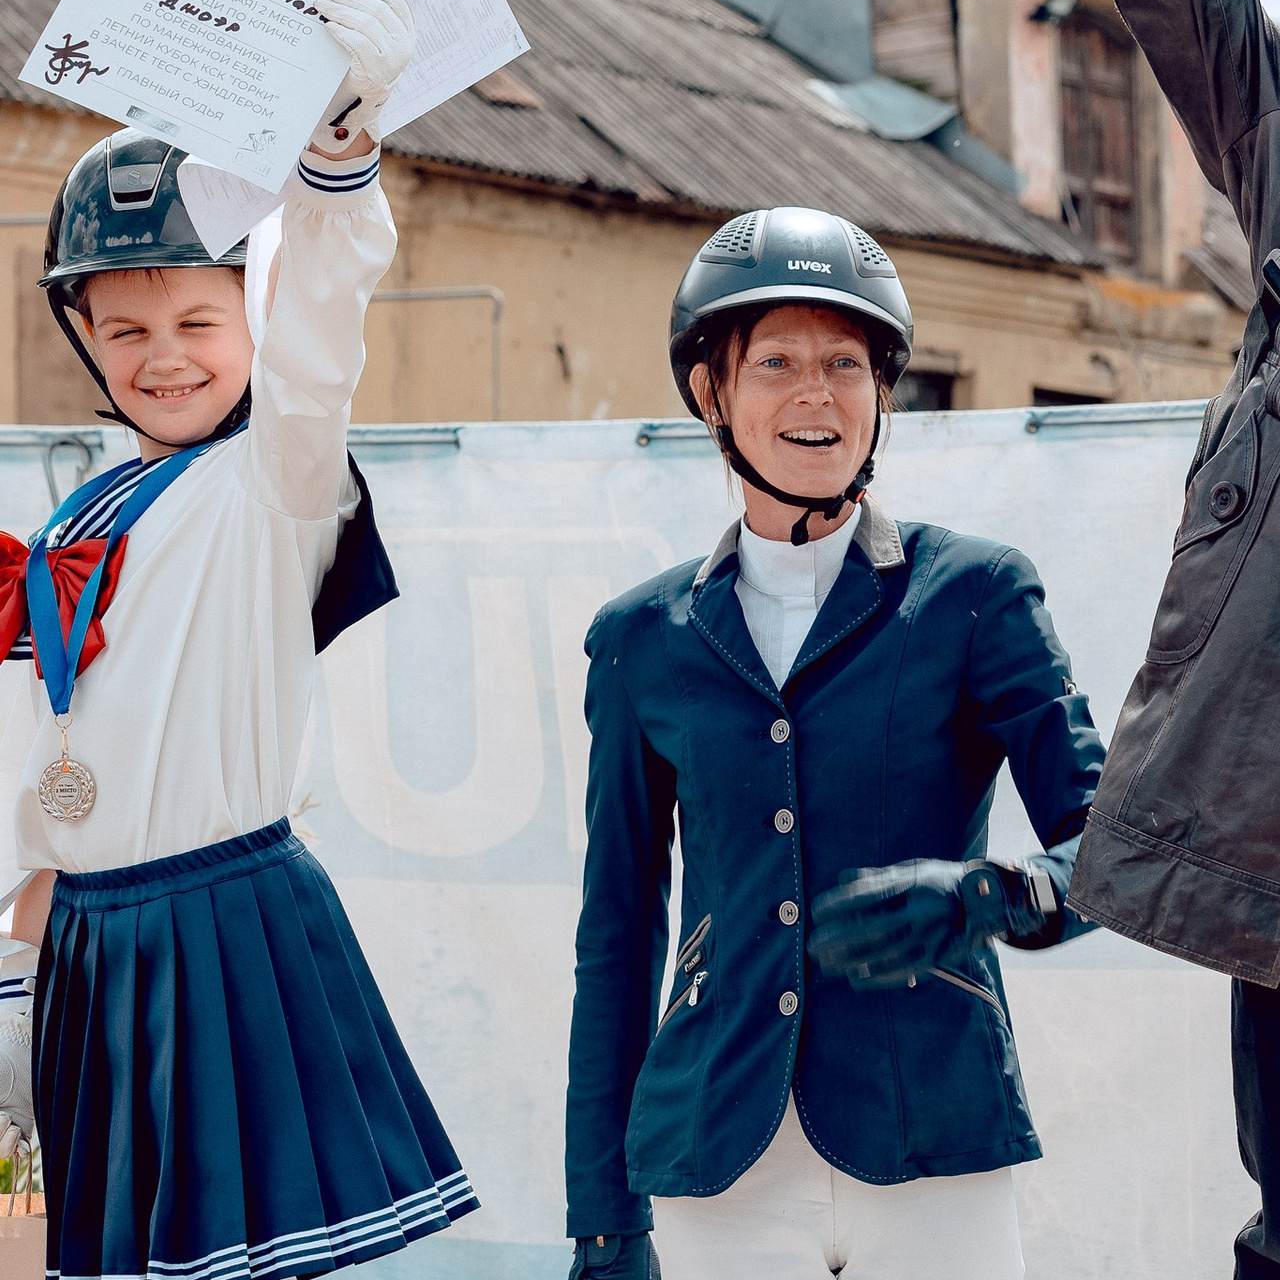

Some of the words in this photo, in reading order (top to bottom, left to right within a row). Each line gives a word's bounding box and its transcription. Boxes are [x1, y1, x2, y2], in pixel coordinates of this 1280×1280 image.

[131, 13, 152, 30] ПО
[153, 24, 232, 66] МАНЕЖНОЙ
[232, 60, 266, 84] ЕЗДЕ
[143, 2, 154, 13] В
[154, 7, 270, 68] СОРЕВНОВАНИЯХ
[226, 7, 247, 23] ПО
[248, 18, 301, 48] КЛИЧКЕ
[259, 6, 268, 16] 2
[268, 10, 314, 37] МЕСТО
[90, 30, 101, 41] В
[101, 34, 150, 63] ЗАЧЕТЕ
[150, 56, 182, 78] ТЕСТ
[182, 71, 194, 83] С
[193, 76, 275, 120] ХЭНДЛЕРОМ
[100, 17, 156, 48] ЛЕТНИЙ
[156, 42, 200, 69] КУБОК
[201, 63, 227, 81] КСК
[227, 75, 280, 106] "ГОРКИ"
[117, 67, 181, 102] ГЛАВНЫЙ
[181, 96, 225, 122] СУДЬЯ
[788, 260, 832, 274] uvex
